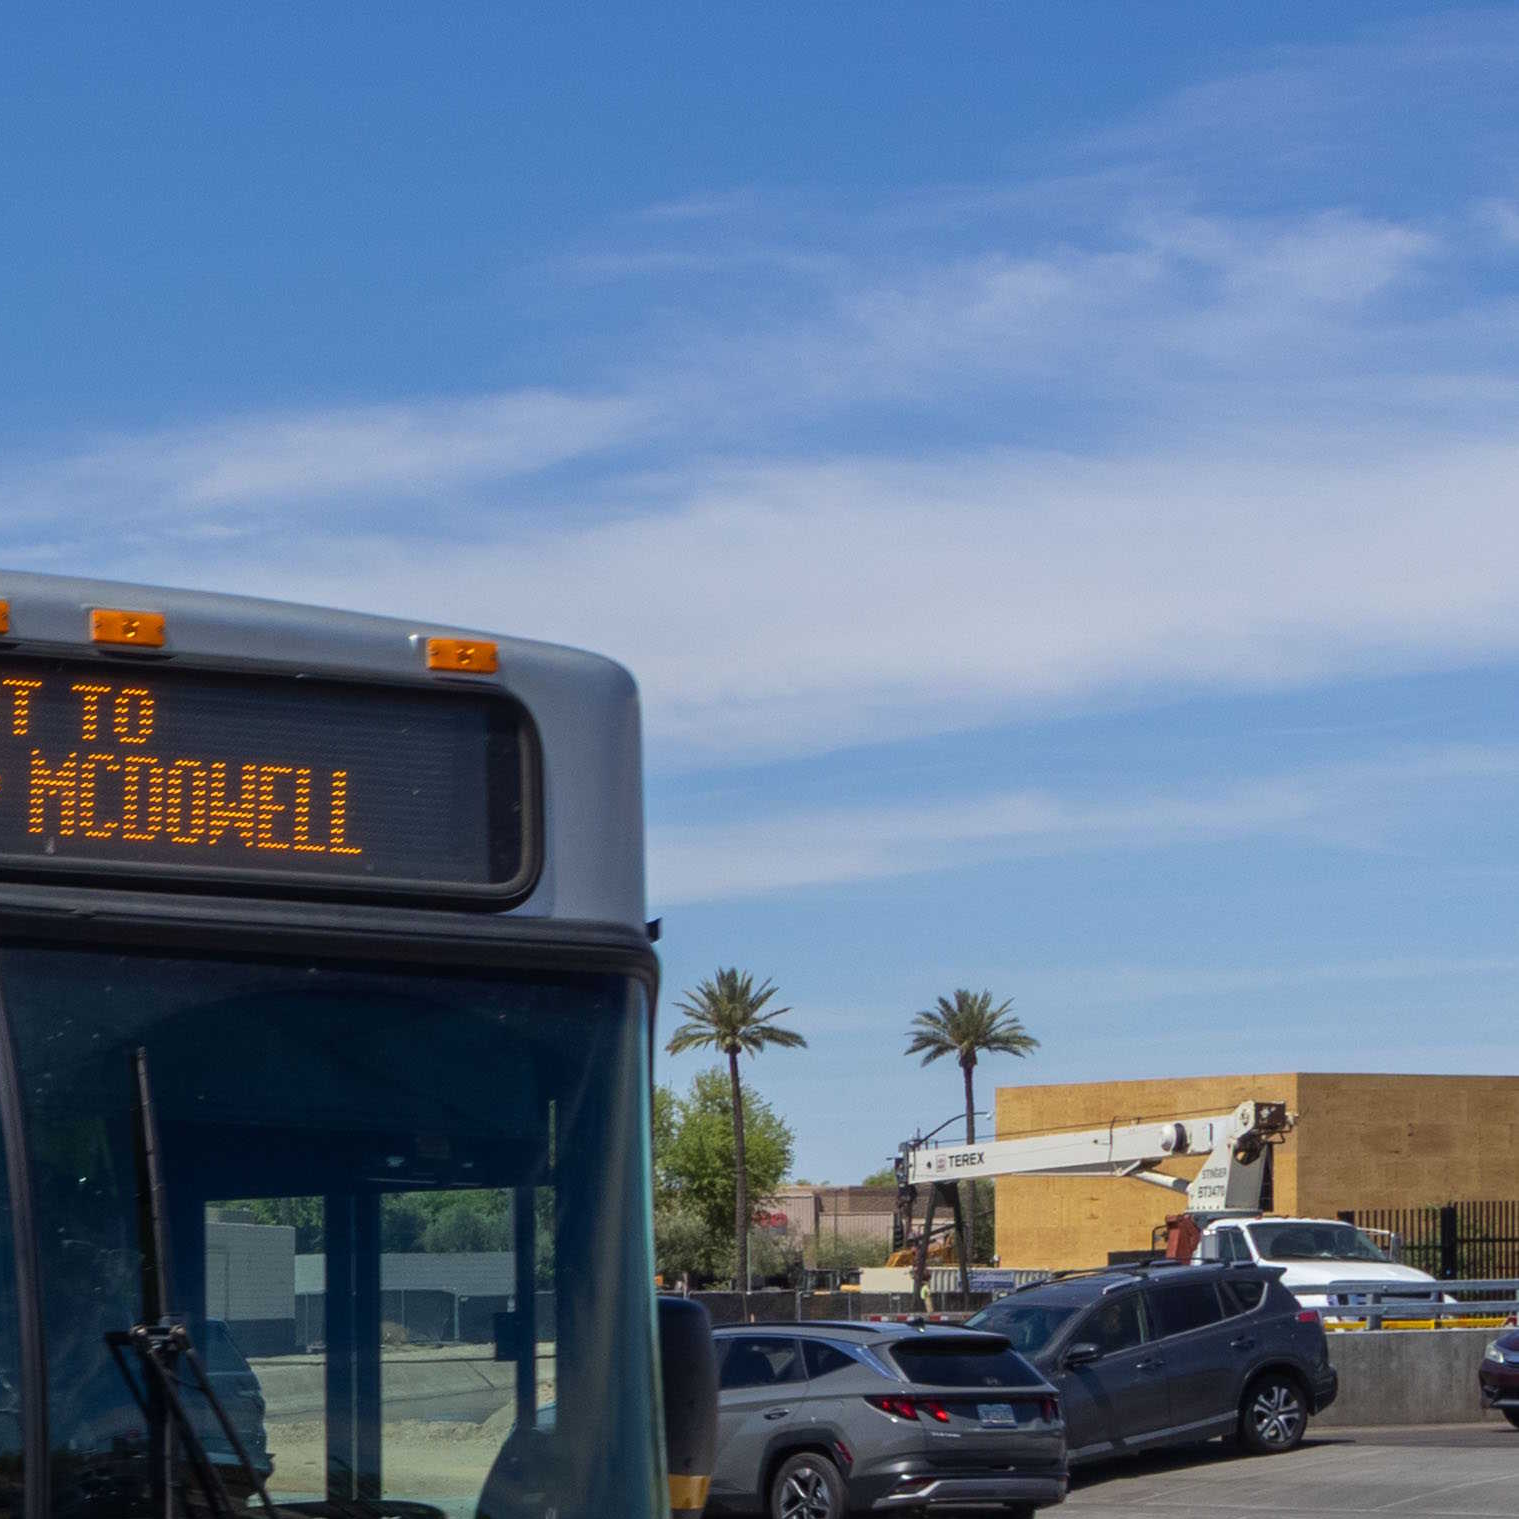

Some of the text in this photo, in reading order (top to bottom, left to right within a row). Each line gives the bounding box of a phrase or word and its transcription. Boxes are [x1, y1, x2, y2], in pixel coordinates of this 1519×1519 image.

[70, 683, 156, 745] TO
[29, 748, 363, 855] MCDOWELL
[948, 1151, 985, 1168] TEREX
